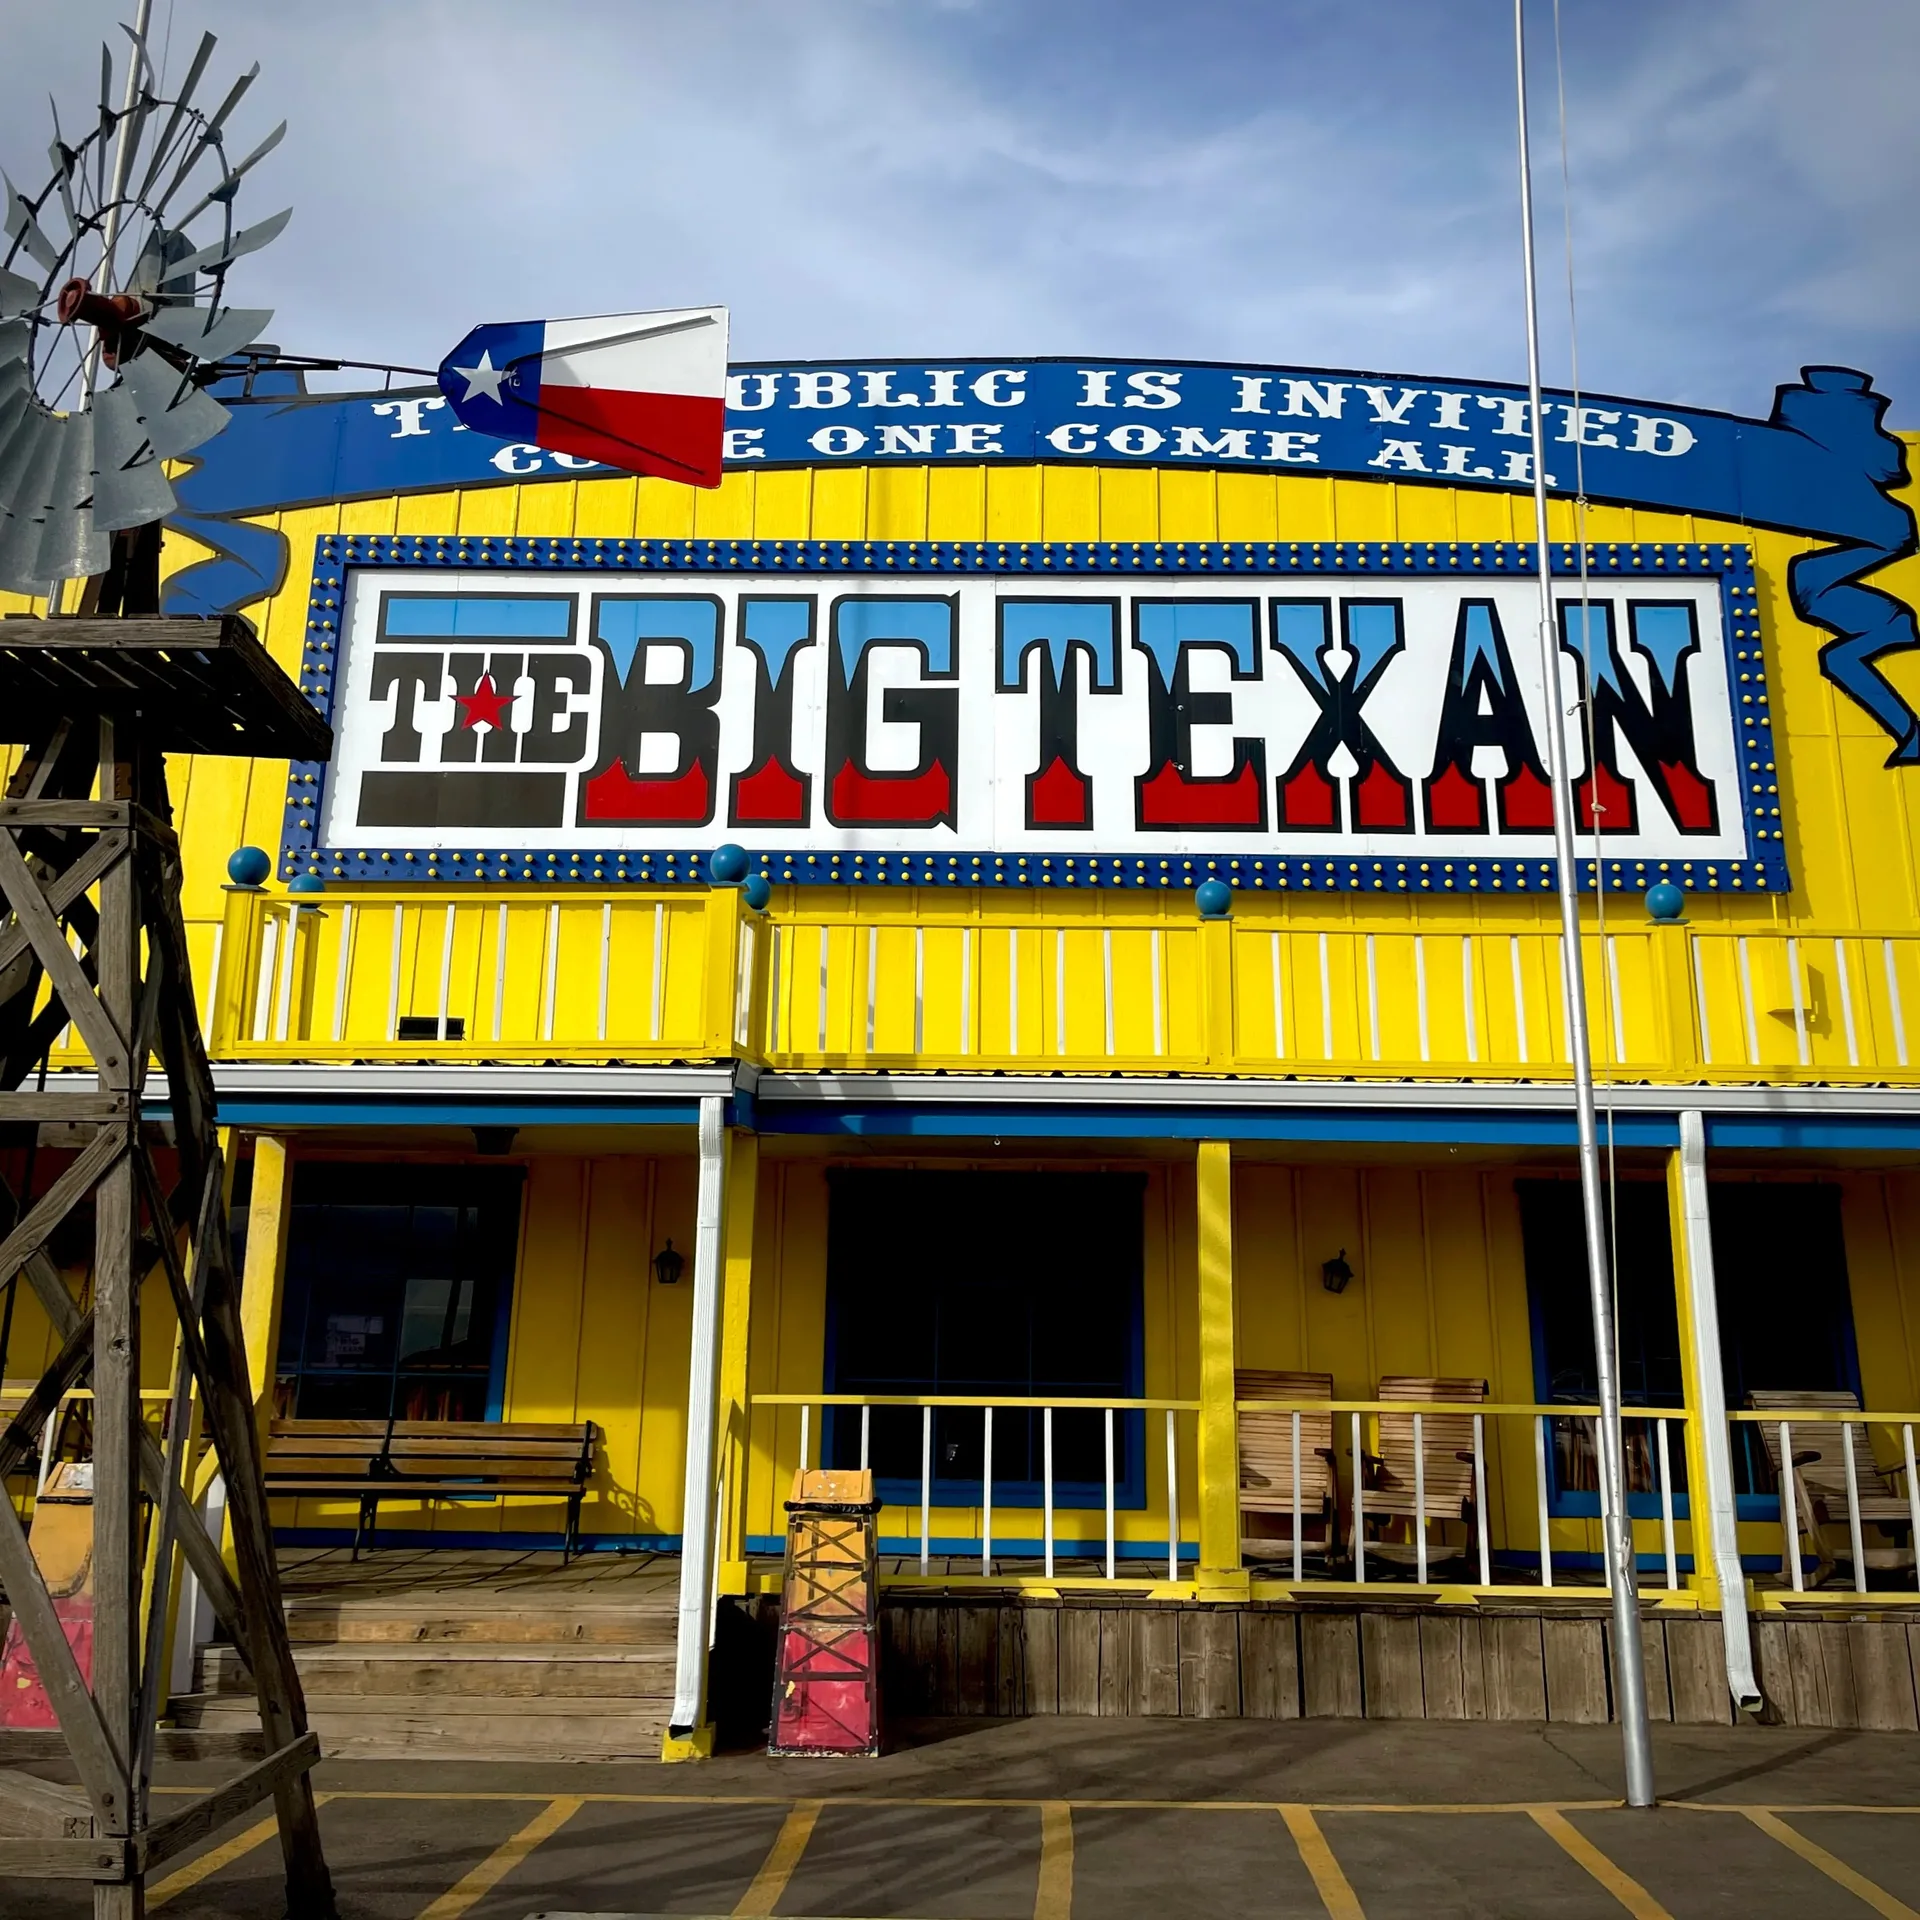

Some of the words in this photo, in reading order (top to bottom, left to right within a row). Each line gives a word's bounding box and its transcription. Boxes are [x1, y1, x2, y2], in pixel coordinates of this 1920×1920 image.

[489, 428, 766, 474] CE
[807, 424, 1004, 456] ONE
[1046, 424, 1321, 464] COME
[1367, 438, 1558, 487] ALL
[725, 370, 1027, 411] UBLIC
[1076, 370, 1183, 410] IS
[1231, 376, 1698, 457] INVITED
[369, 652, 590, 763] THE
[575, 590, 960, 833] BIG
[995, 596, 1719, 837] TEXAN
